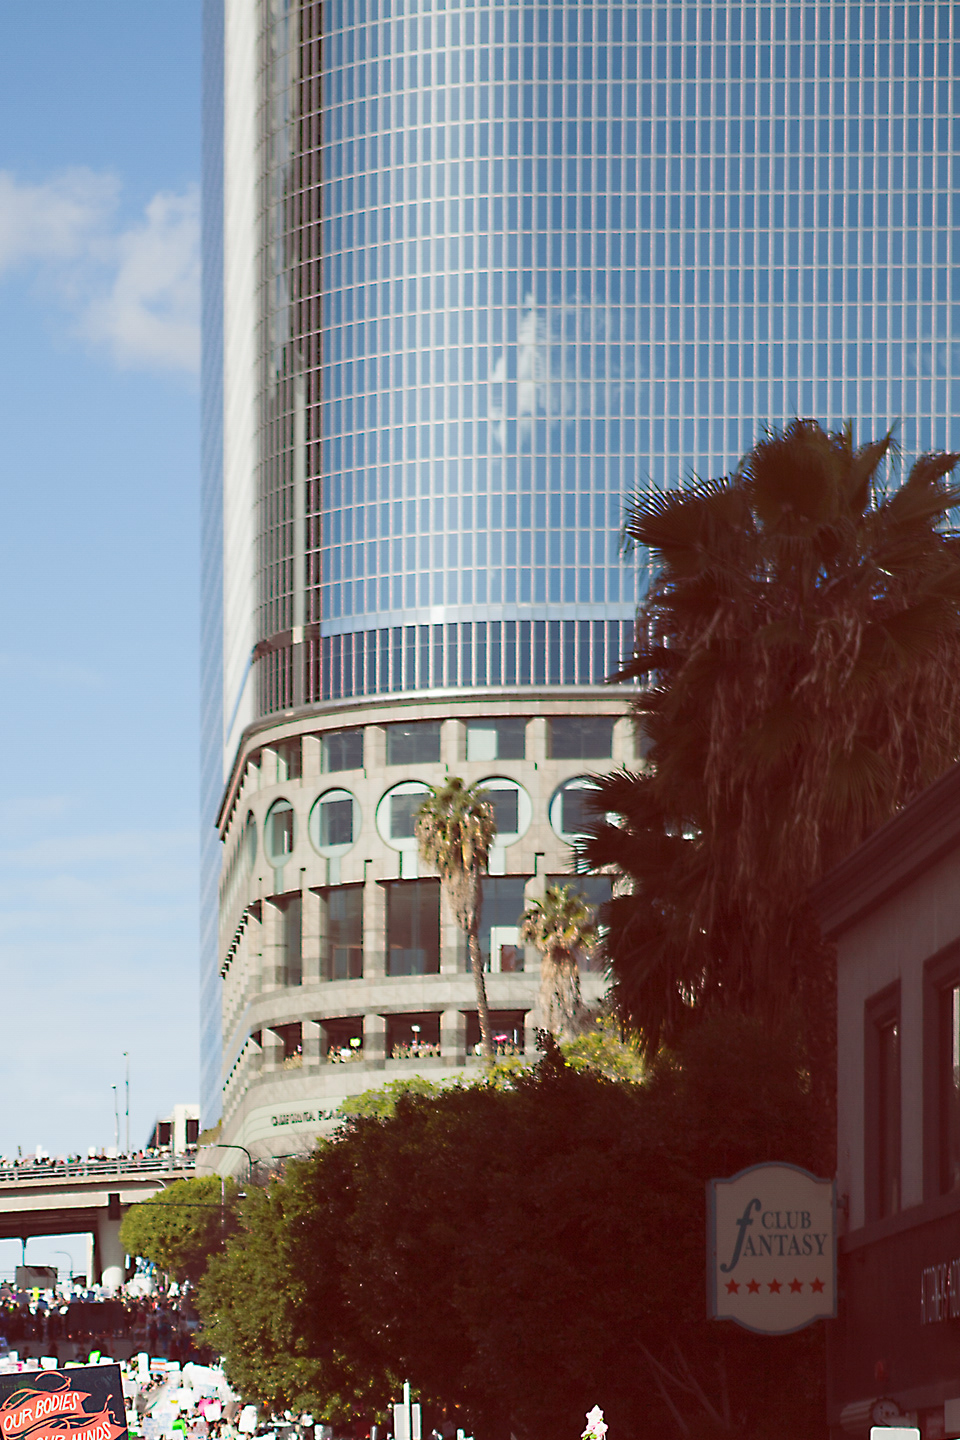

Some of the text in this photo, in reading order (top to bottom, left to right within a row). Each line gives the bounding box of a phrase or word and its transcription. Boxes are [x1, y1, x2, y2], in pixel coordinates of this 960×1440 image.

[761, 1211, 812, 1230] CLUB
[3, 1392, 80, 1432] OUR BODIES
